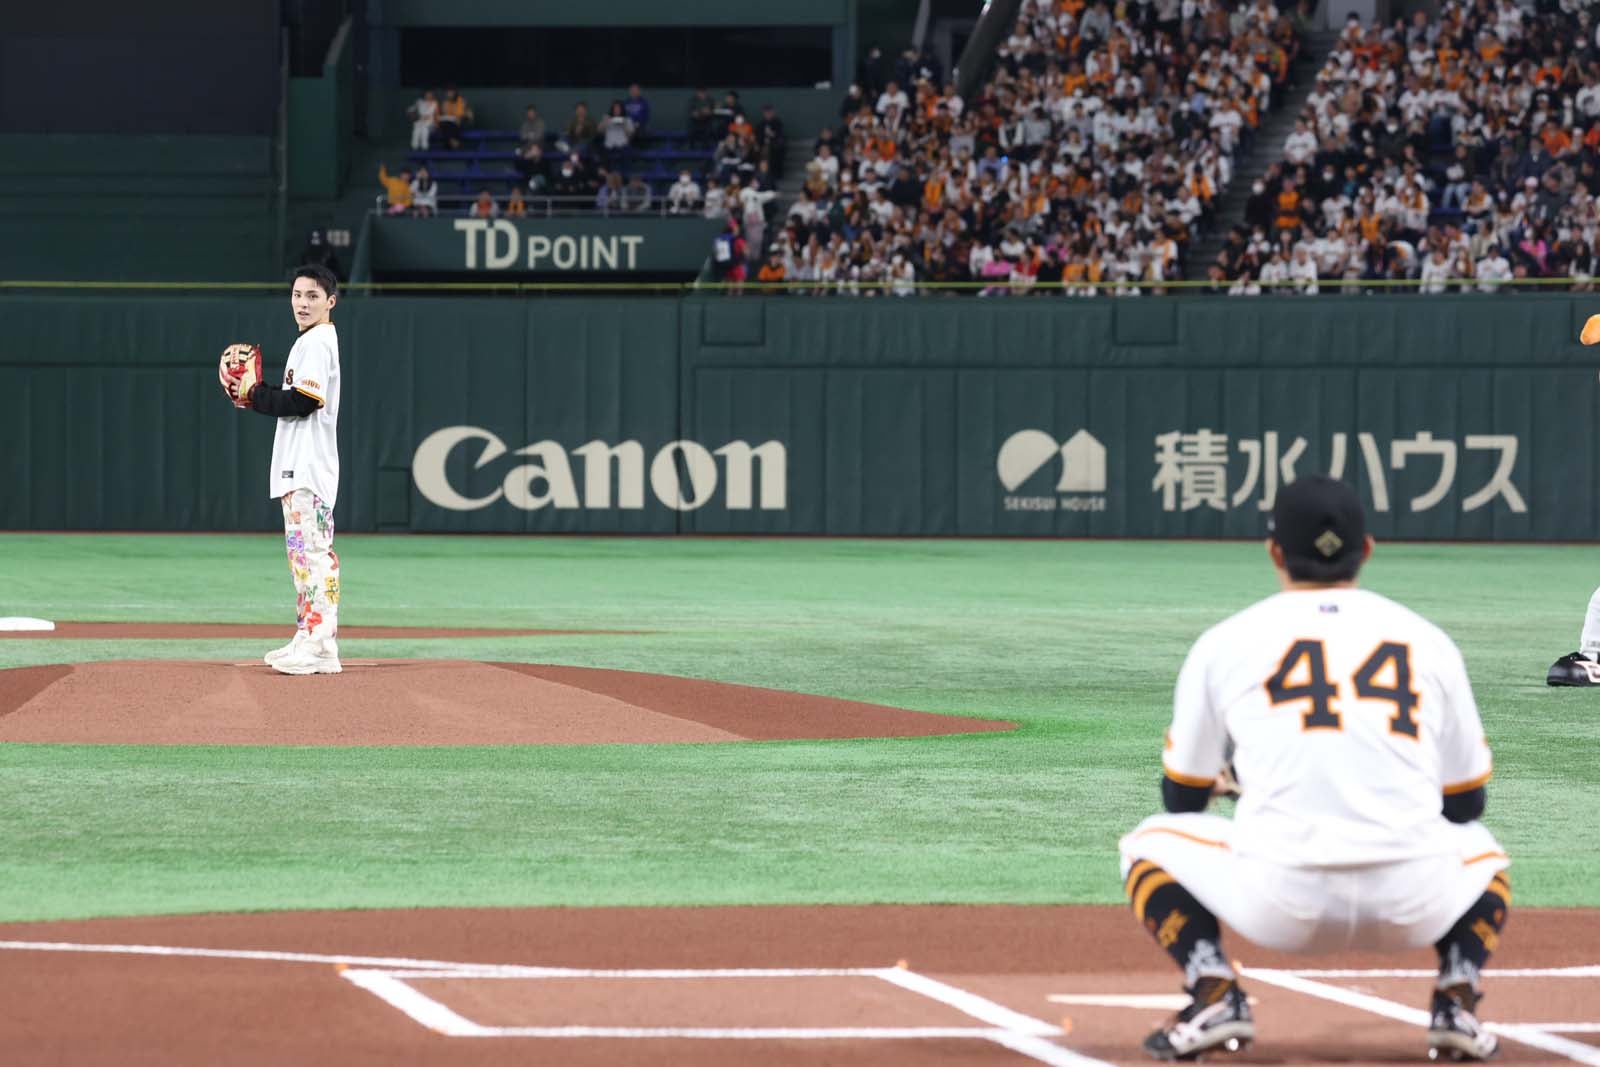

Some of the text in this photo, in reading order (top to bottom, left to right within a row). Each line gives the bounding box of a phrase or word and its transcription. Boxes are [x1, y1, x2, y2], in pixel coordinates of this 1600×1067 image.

[453, 218, 644, 270] TD POINT
[412, 425, 787, 511] Canon
[1152, 428, 1528, 513] 積水ハウス
[1264, 638, 1421, 743] 44
